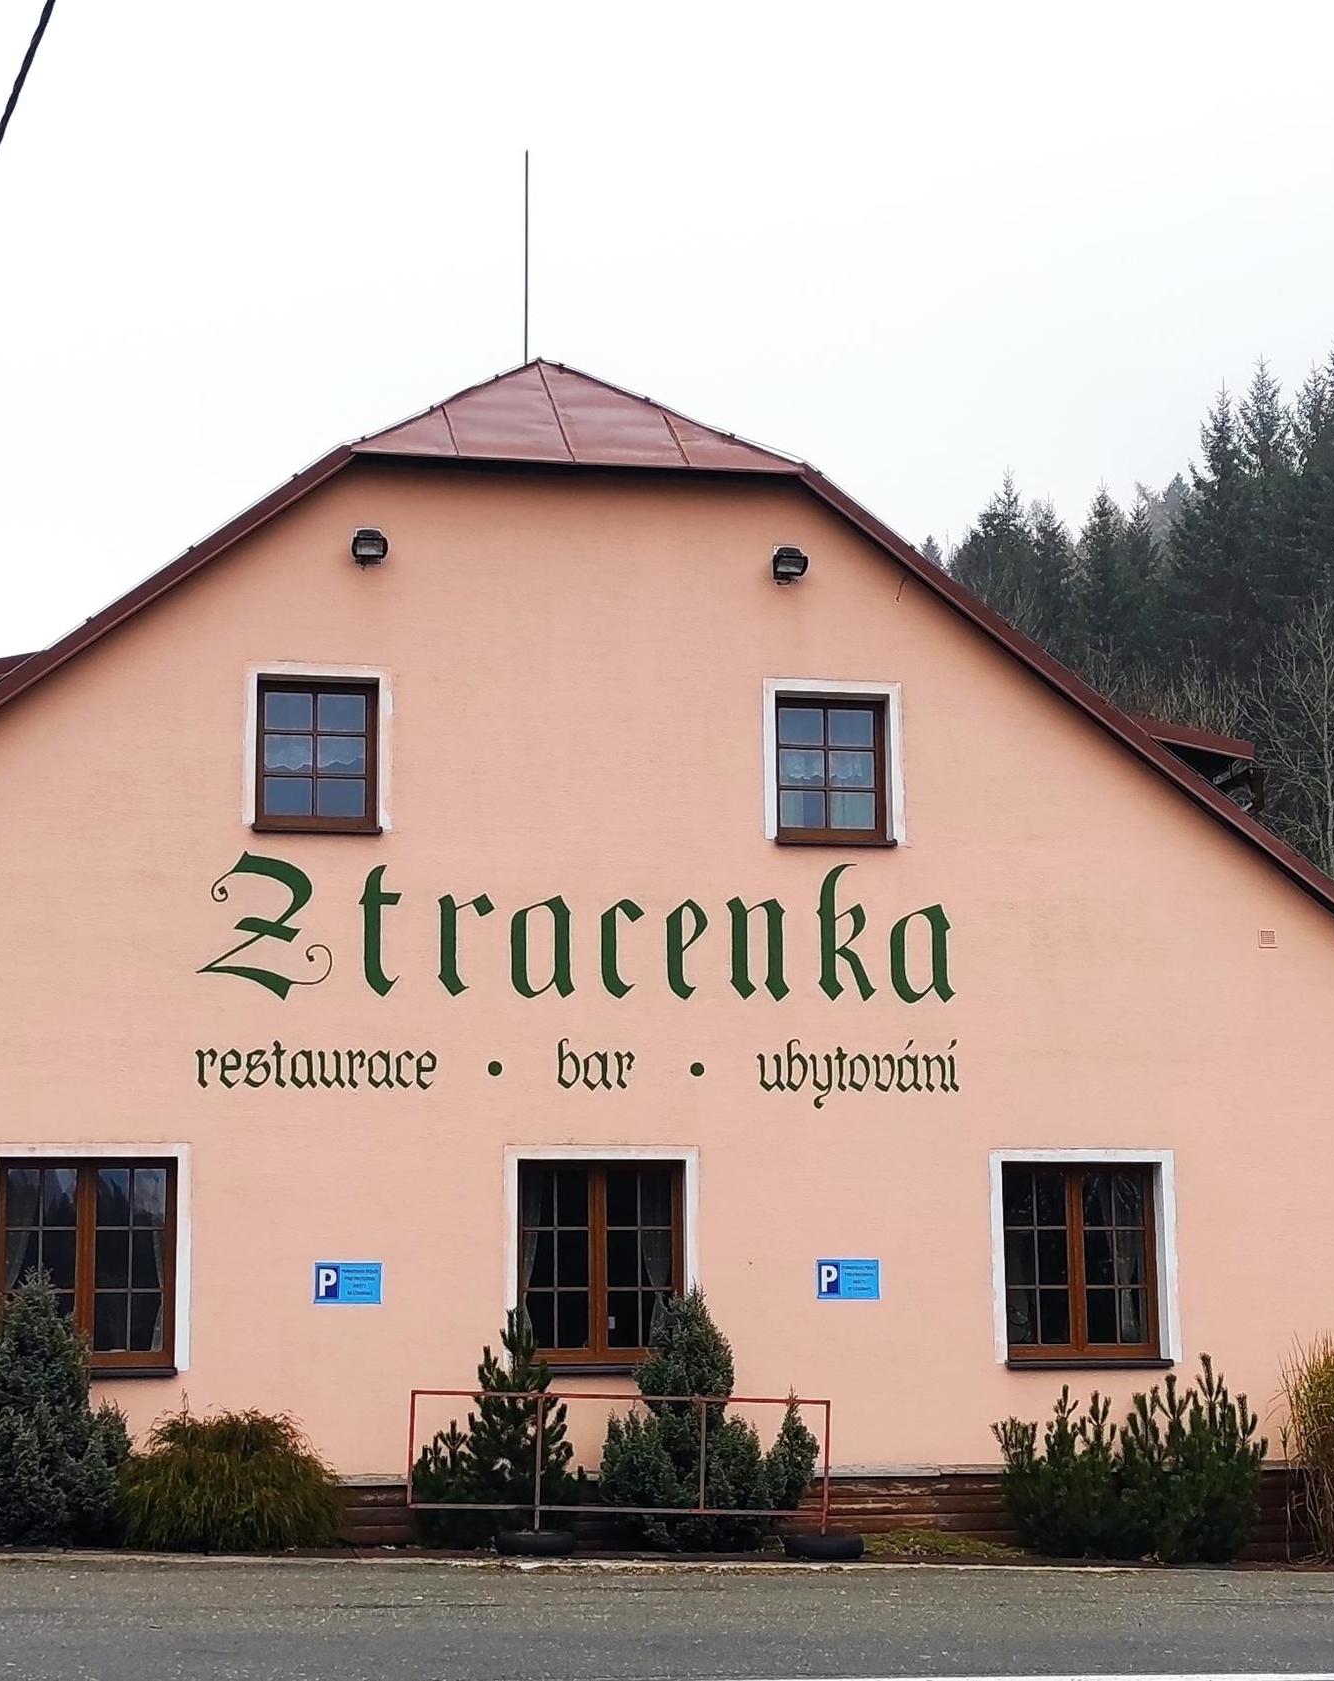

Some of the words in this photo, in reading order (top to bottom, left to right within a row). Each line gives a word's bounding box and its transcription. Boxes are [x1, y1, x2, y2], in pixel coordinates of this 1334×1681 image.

[195, 850, 956, 1004] Ztracenka
[194, 1039, 437, 1091] restaurace
[557, 1037, 636, 1091] bar
[756, 1038, 960, 1110] ubytování
[319, 1268, 337, 1297] P
[821, 1265, 838, 1293] P
